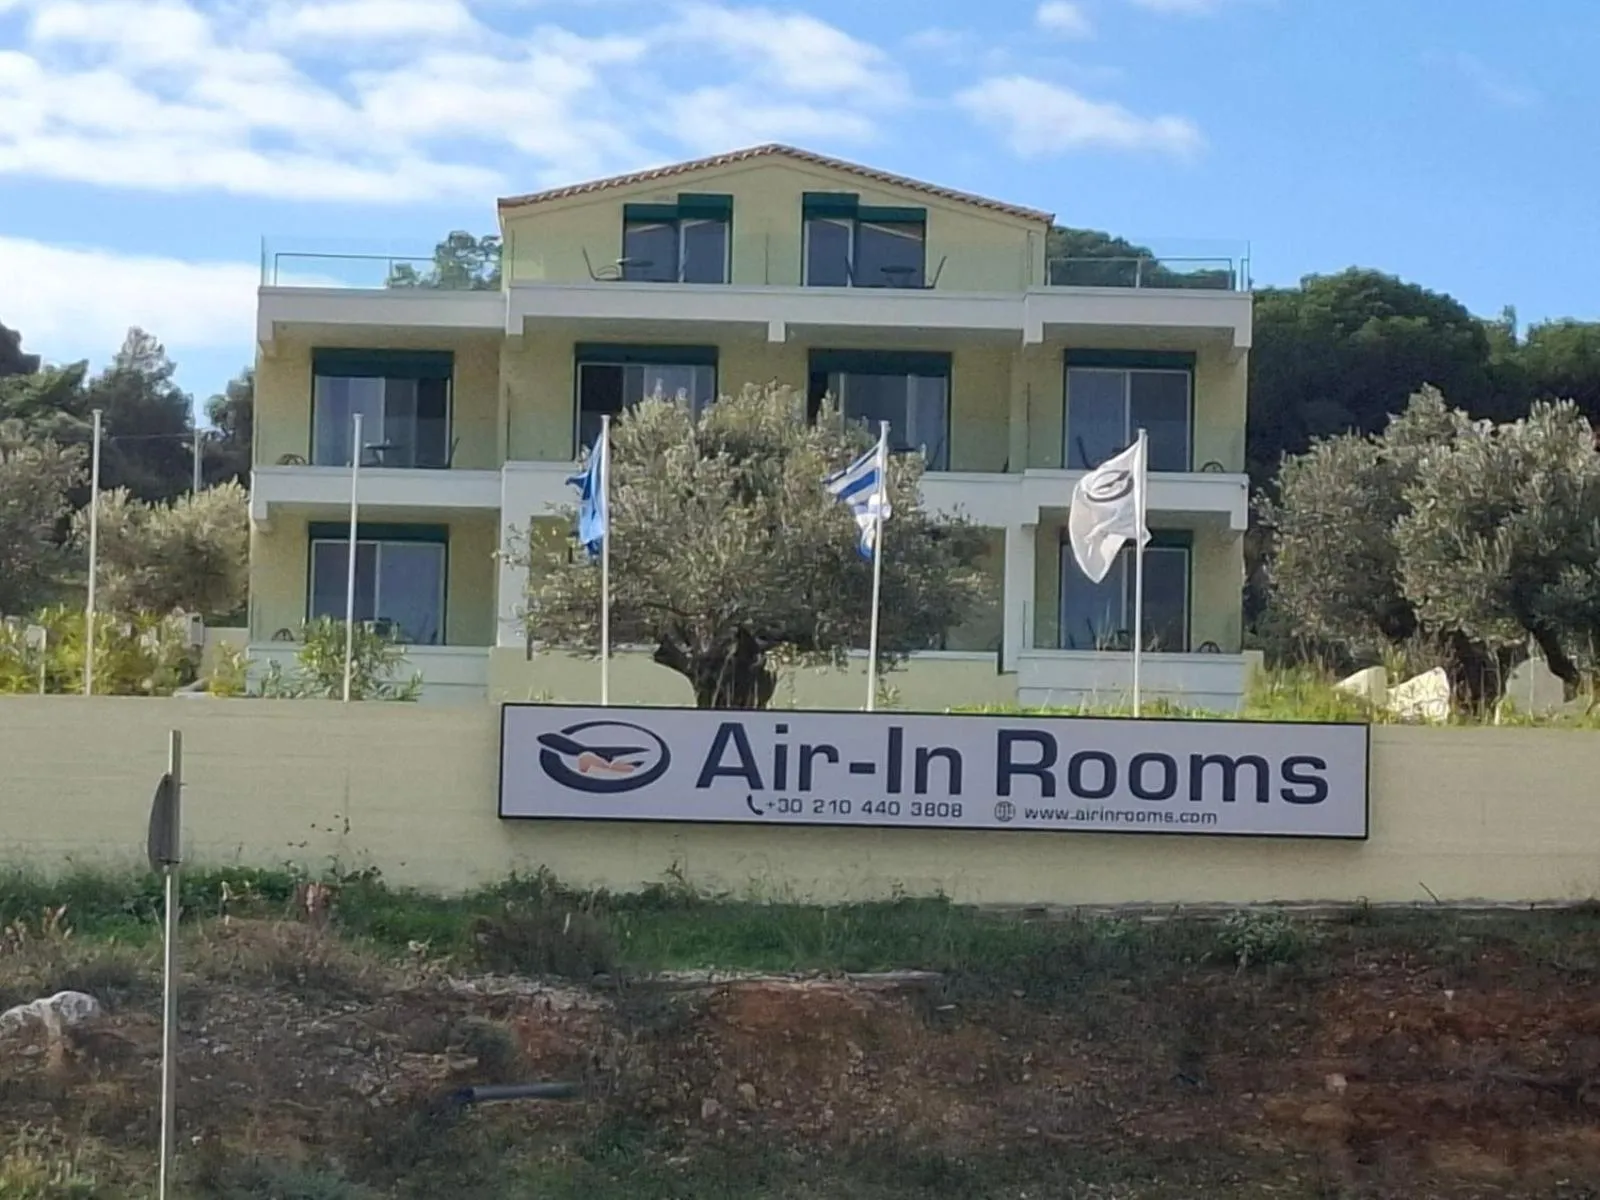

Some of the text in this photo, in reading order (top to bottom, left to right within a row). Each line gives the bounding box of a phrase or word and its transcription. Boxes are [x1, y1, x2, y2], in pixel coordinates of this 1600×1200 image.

[695, 722, 1329, 805] Air-In Rooms
[766, 799, 963, 818] +30 210 440 3808
[1024, 806, 1218, 825] www.airinrooms.com
